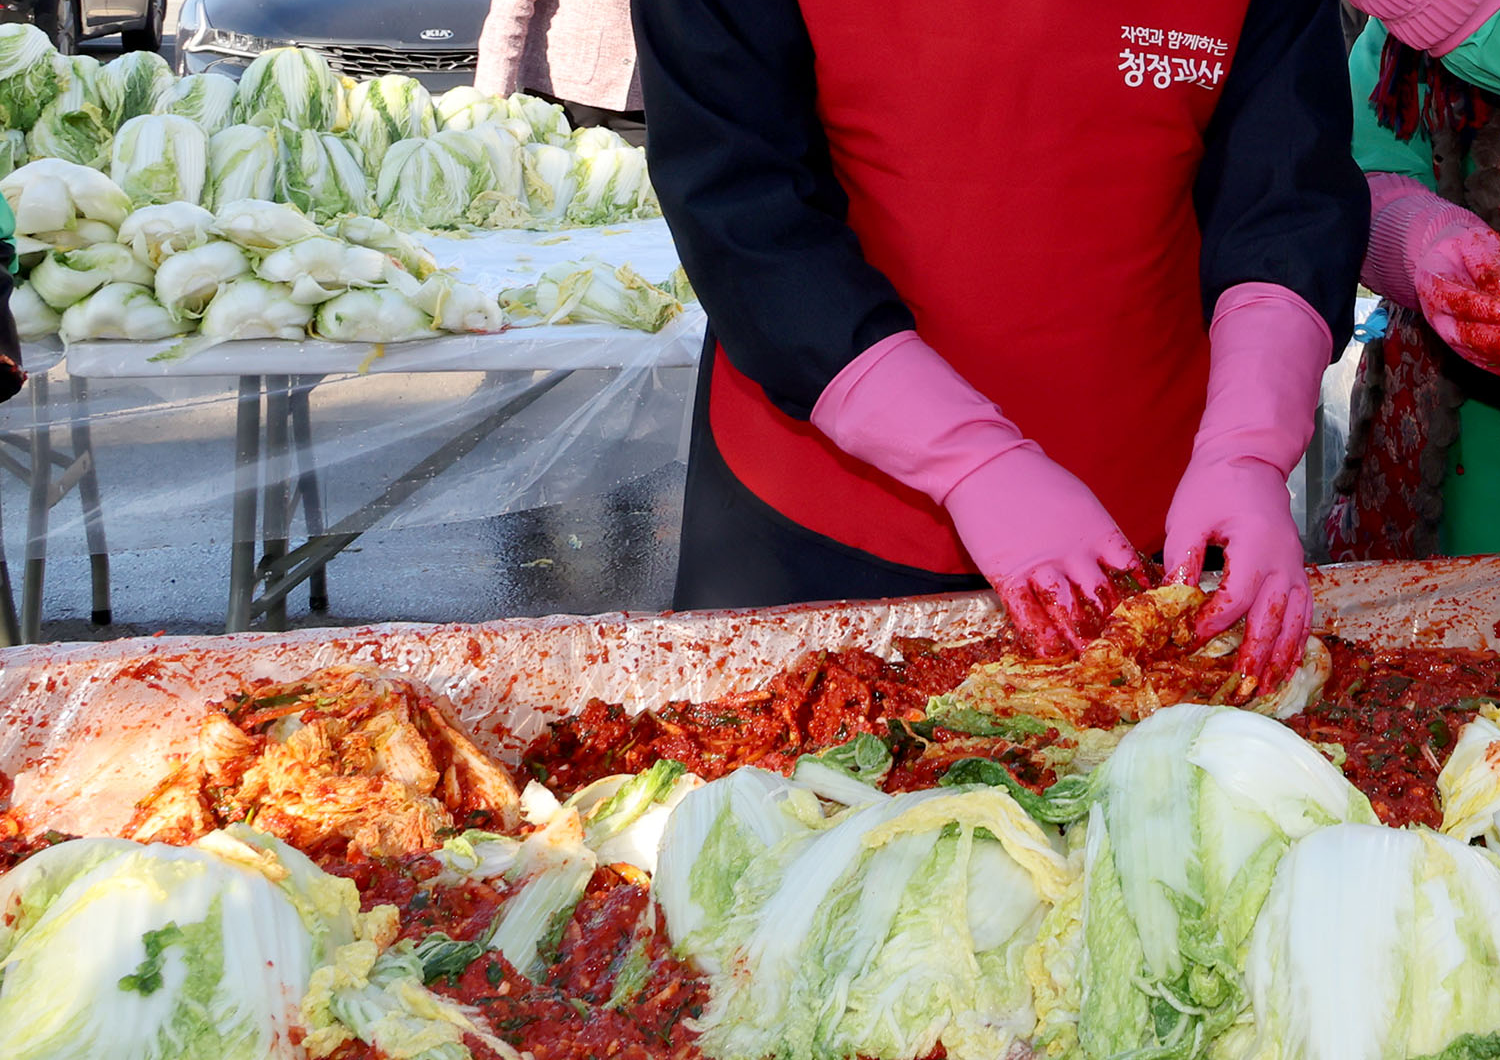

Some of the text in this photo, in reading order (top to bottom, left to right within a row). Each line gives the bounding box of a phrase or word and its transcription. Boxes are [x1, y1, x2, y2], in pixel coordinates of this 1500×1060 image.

[424, 28, 450, 38] KIA
[1120, 25, 1228, 56] 자연과 함께하는
[1117, 47, 1224, 90] 청정괴산
